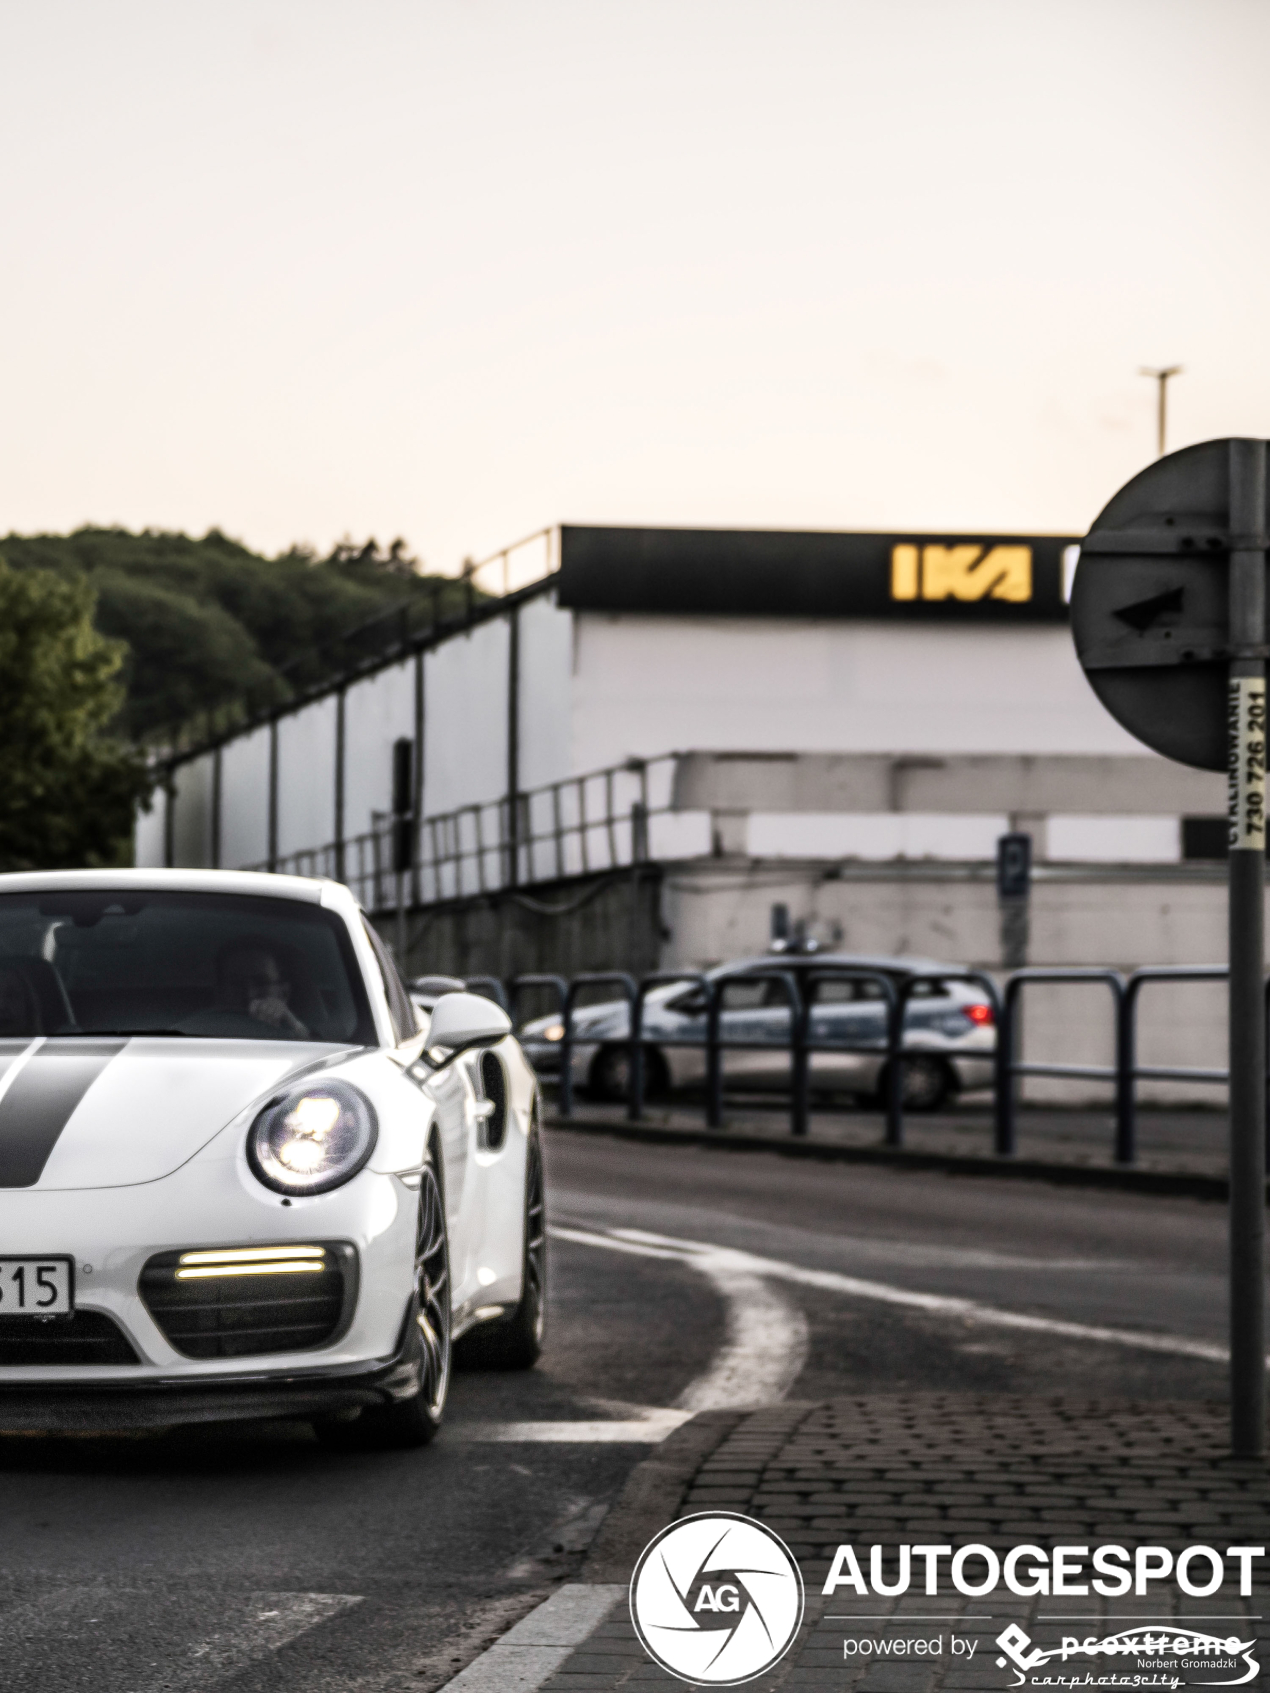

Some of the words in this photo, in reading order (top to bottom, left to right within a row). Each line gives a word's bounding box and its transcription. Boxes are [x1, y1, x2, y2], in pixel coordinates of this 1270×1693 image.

[1246, 691, 1265, 733] 201
[1246, 740, 1264, 784] 726
[1246, 791, 1264, 836] 730
